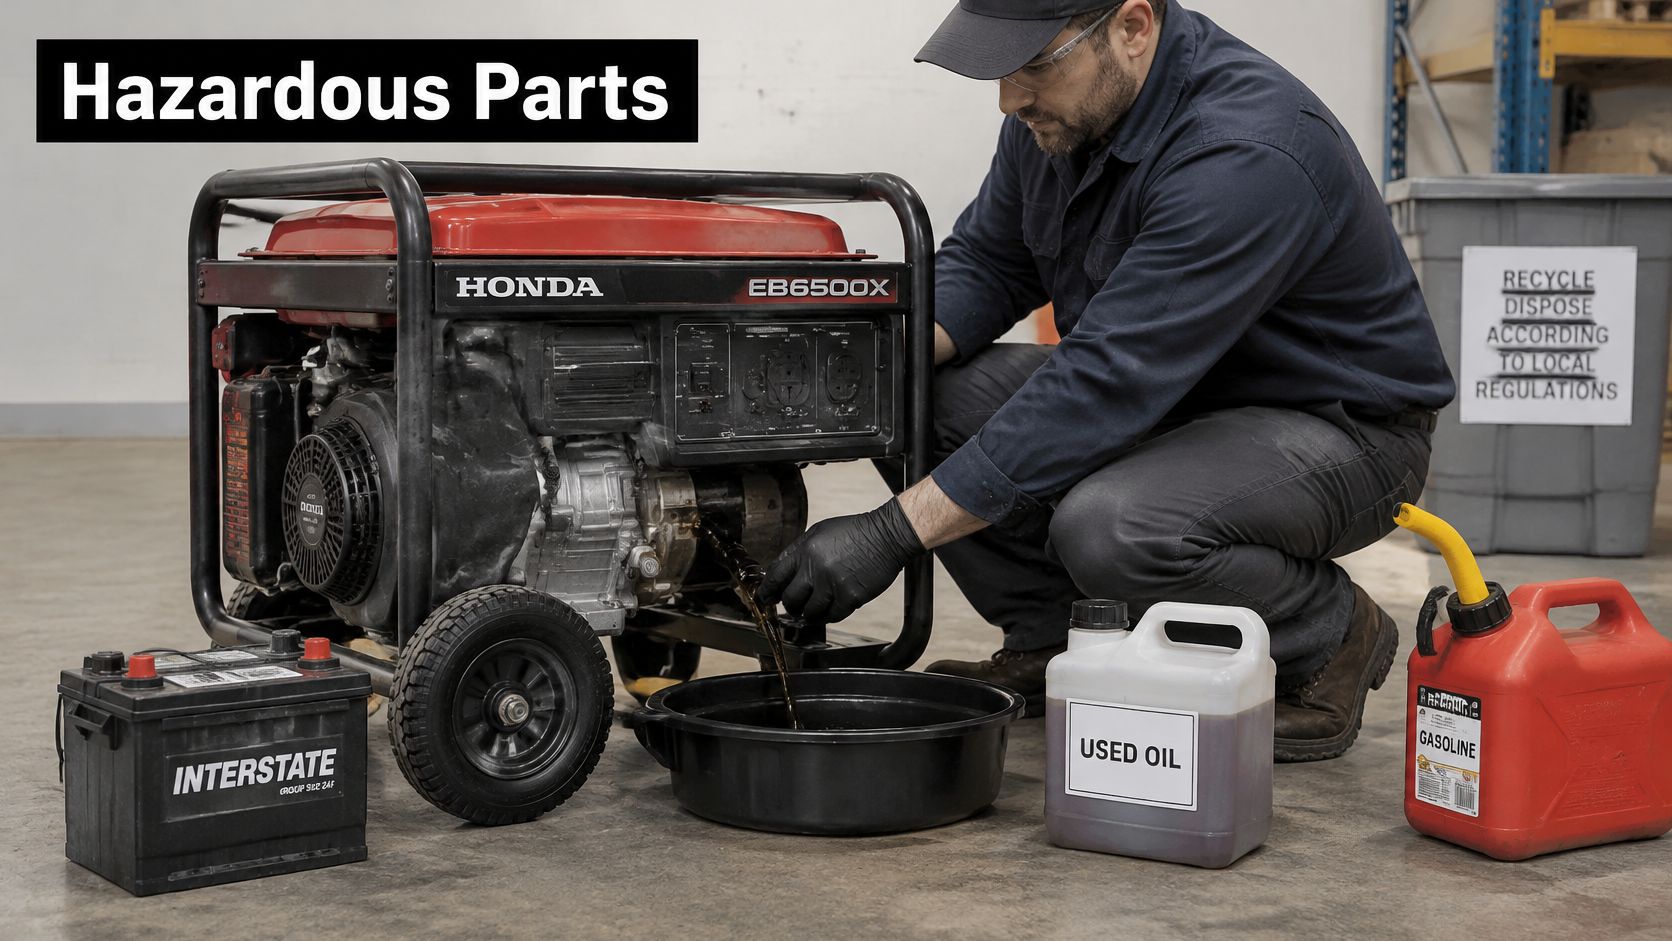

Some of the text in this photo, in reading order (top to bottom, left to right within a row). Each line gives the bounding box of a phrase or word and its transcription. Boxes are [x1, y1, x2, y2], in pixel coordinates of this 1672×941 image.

[456, 277, 604, 297] HONDA
[749, 278, 890, 297] EB6500X
[1503, 270, 1594, 289] RECYCLE
[1505, 297, 1592, 315] DISPOSE
[1486, 326, 1609, 344] ACCORDING
[1500, 353, 1595, 372] TO LOCAL
[1475, 381, 1618, 400] REGULATIONS
[1080, 738, 1181, 769] USED OIL
[1420, 730, 1476, 759] GASOLINE
[173, 748, 336, 795] INTERSTATE
